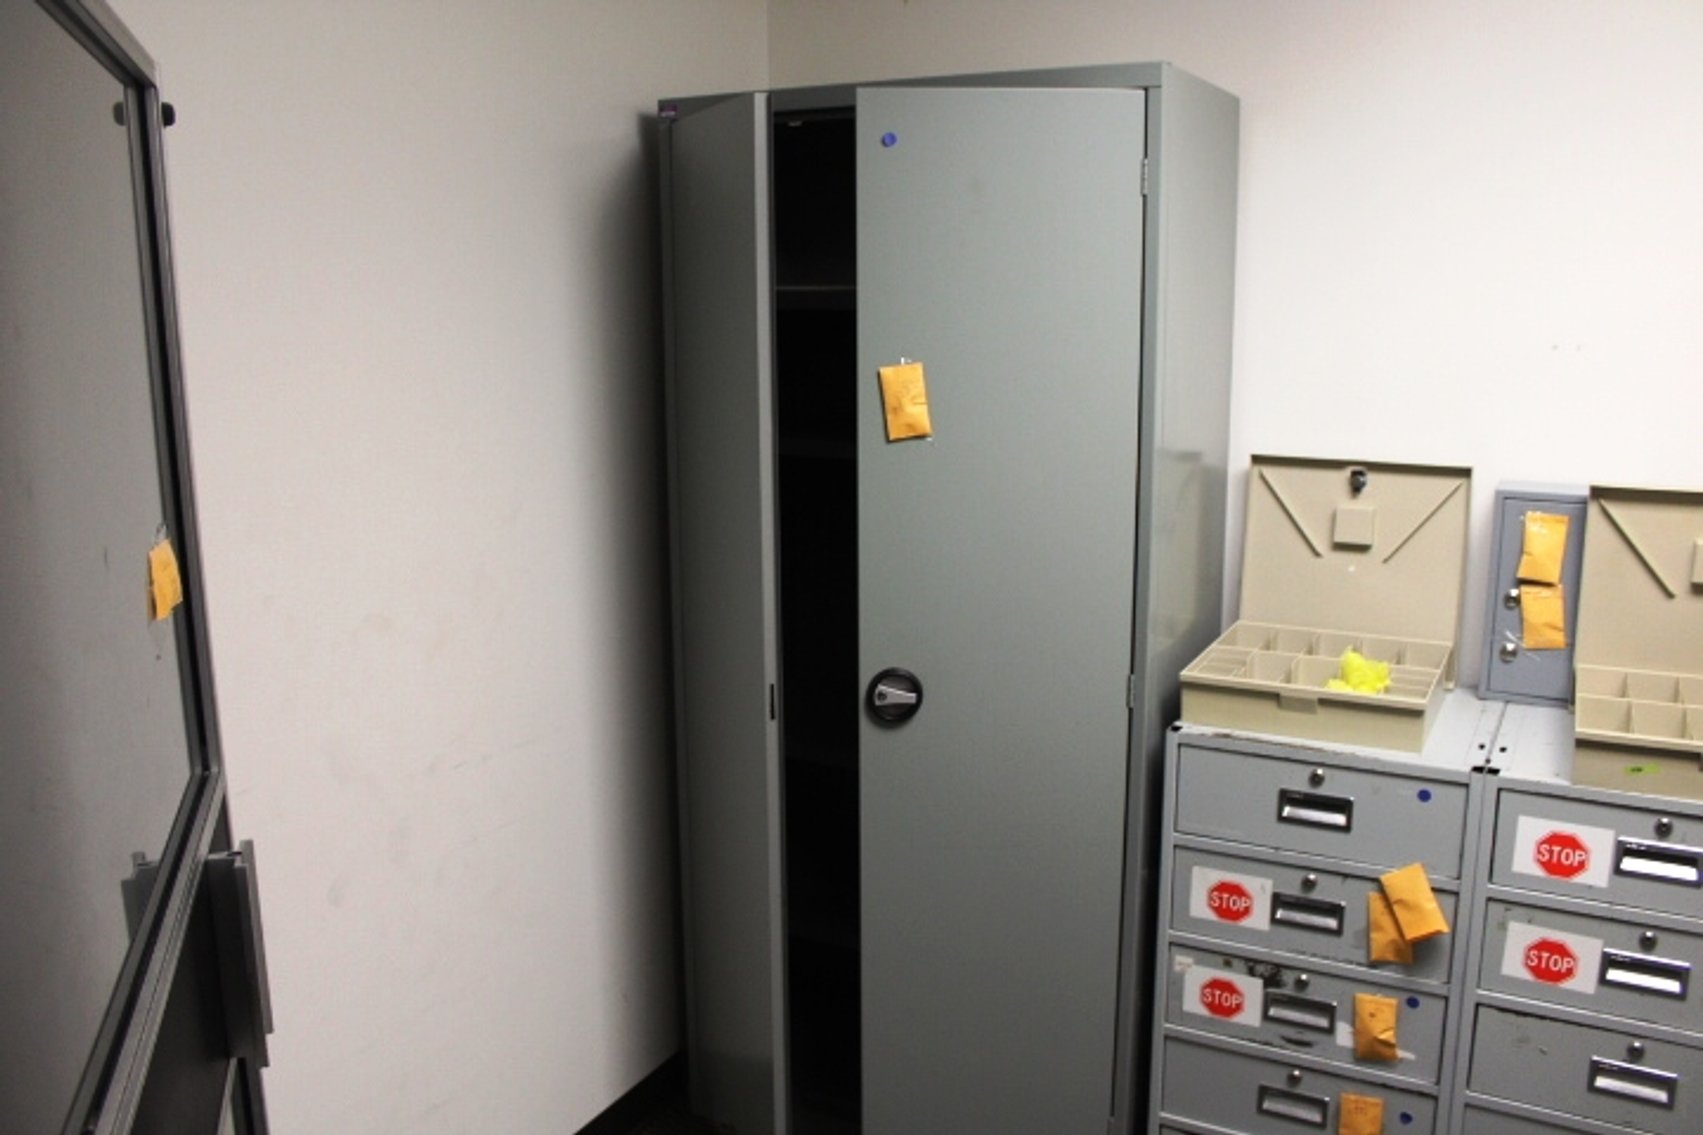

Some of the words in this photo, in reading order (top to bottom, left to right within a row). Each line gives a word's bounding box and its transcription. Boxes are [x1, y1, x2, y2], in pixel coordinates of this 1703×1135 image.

[1538, 844, 1586, 867] STOP
[1209, 891, 1251, 911] STOP
[1527, 950, 1574, 973] STOP
[1202, 988, 1243, 1008] STOP
